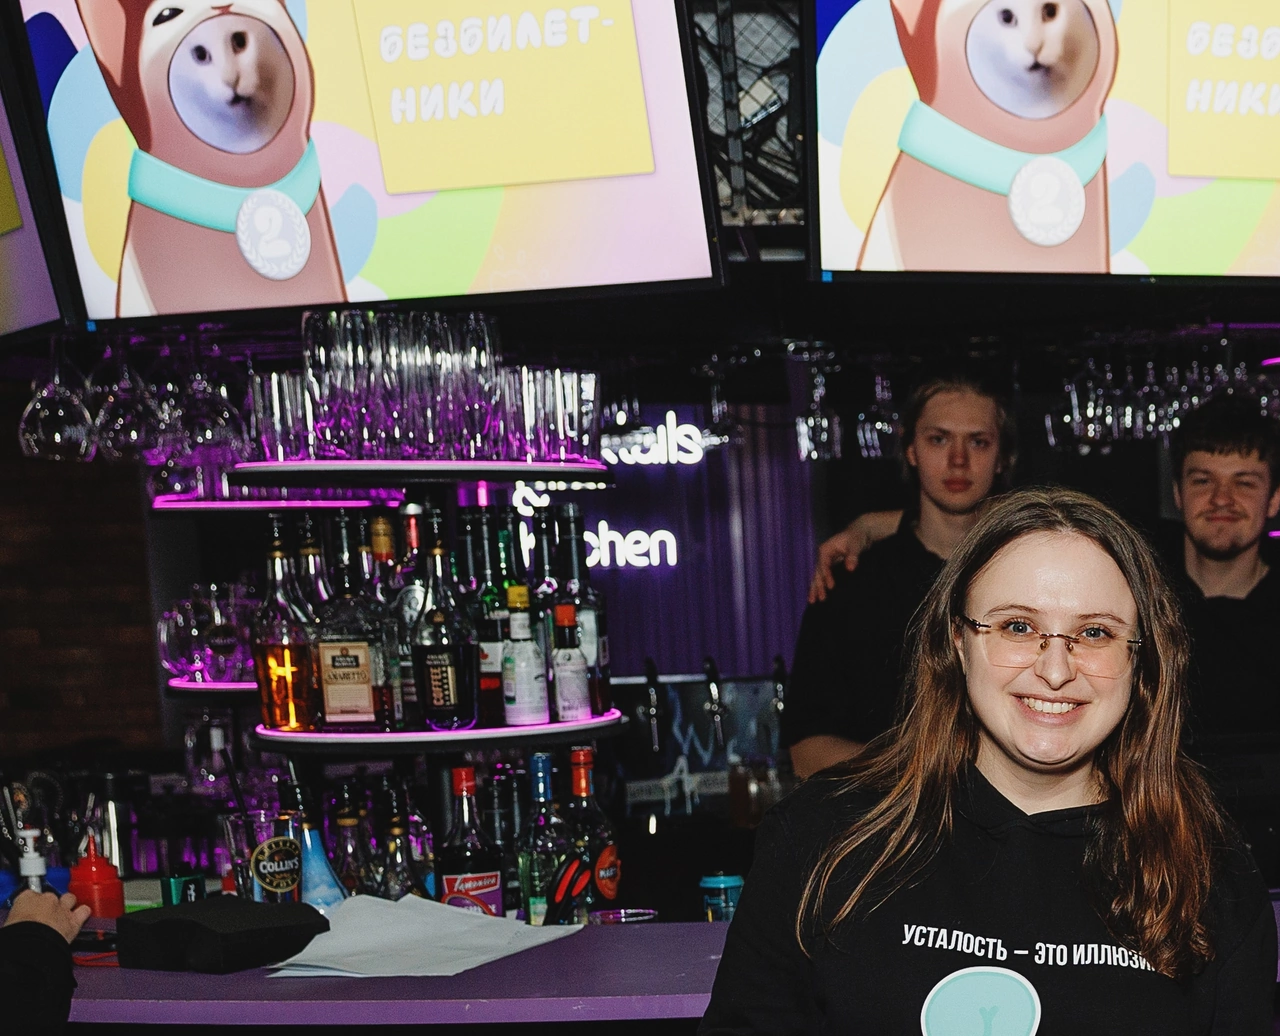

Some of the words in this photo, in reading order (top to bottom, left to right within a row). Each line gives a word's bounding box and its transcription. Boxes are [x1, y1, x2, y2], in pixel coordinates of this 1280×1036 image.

[390, 78, 505, 124] НИКИ
[902, 924, 1008, 960] УСТАЛОСТЬ
[1034, 942, 1068, 966] ЭТО
